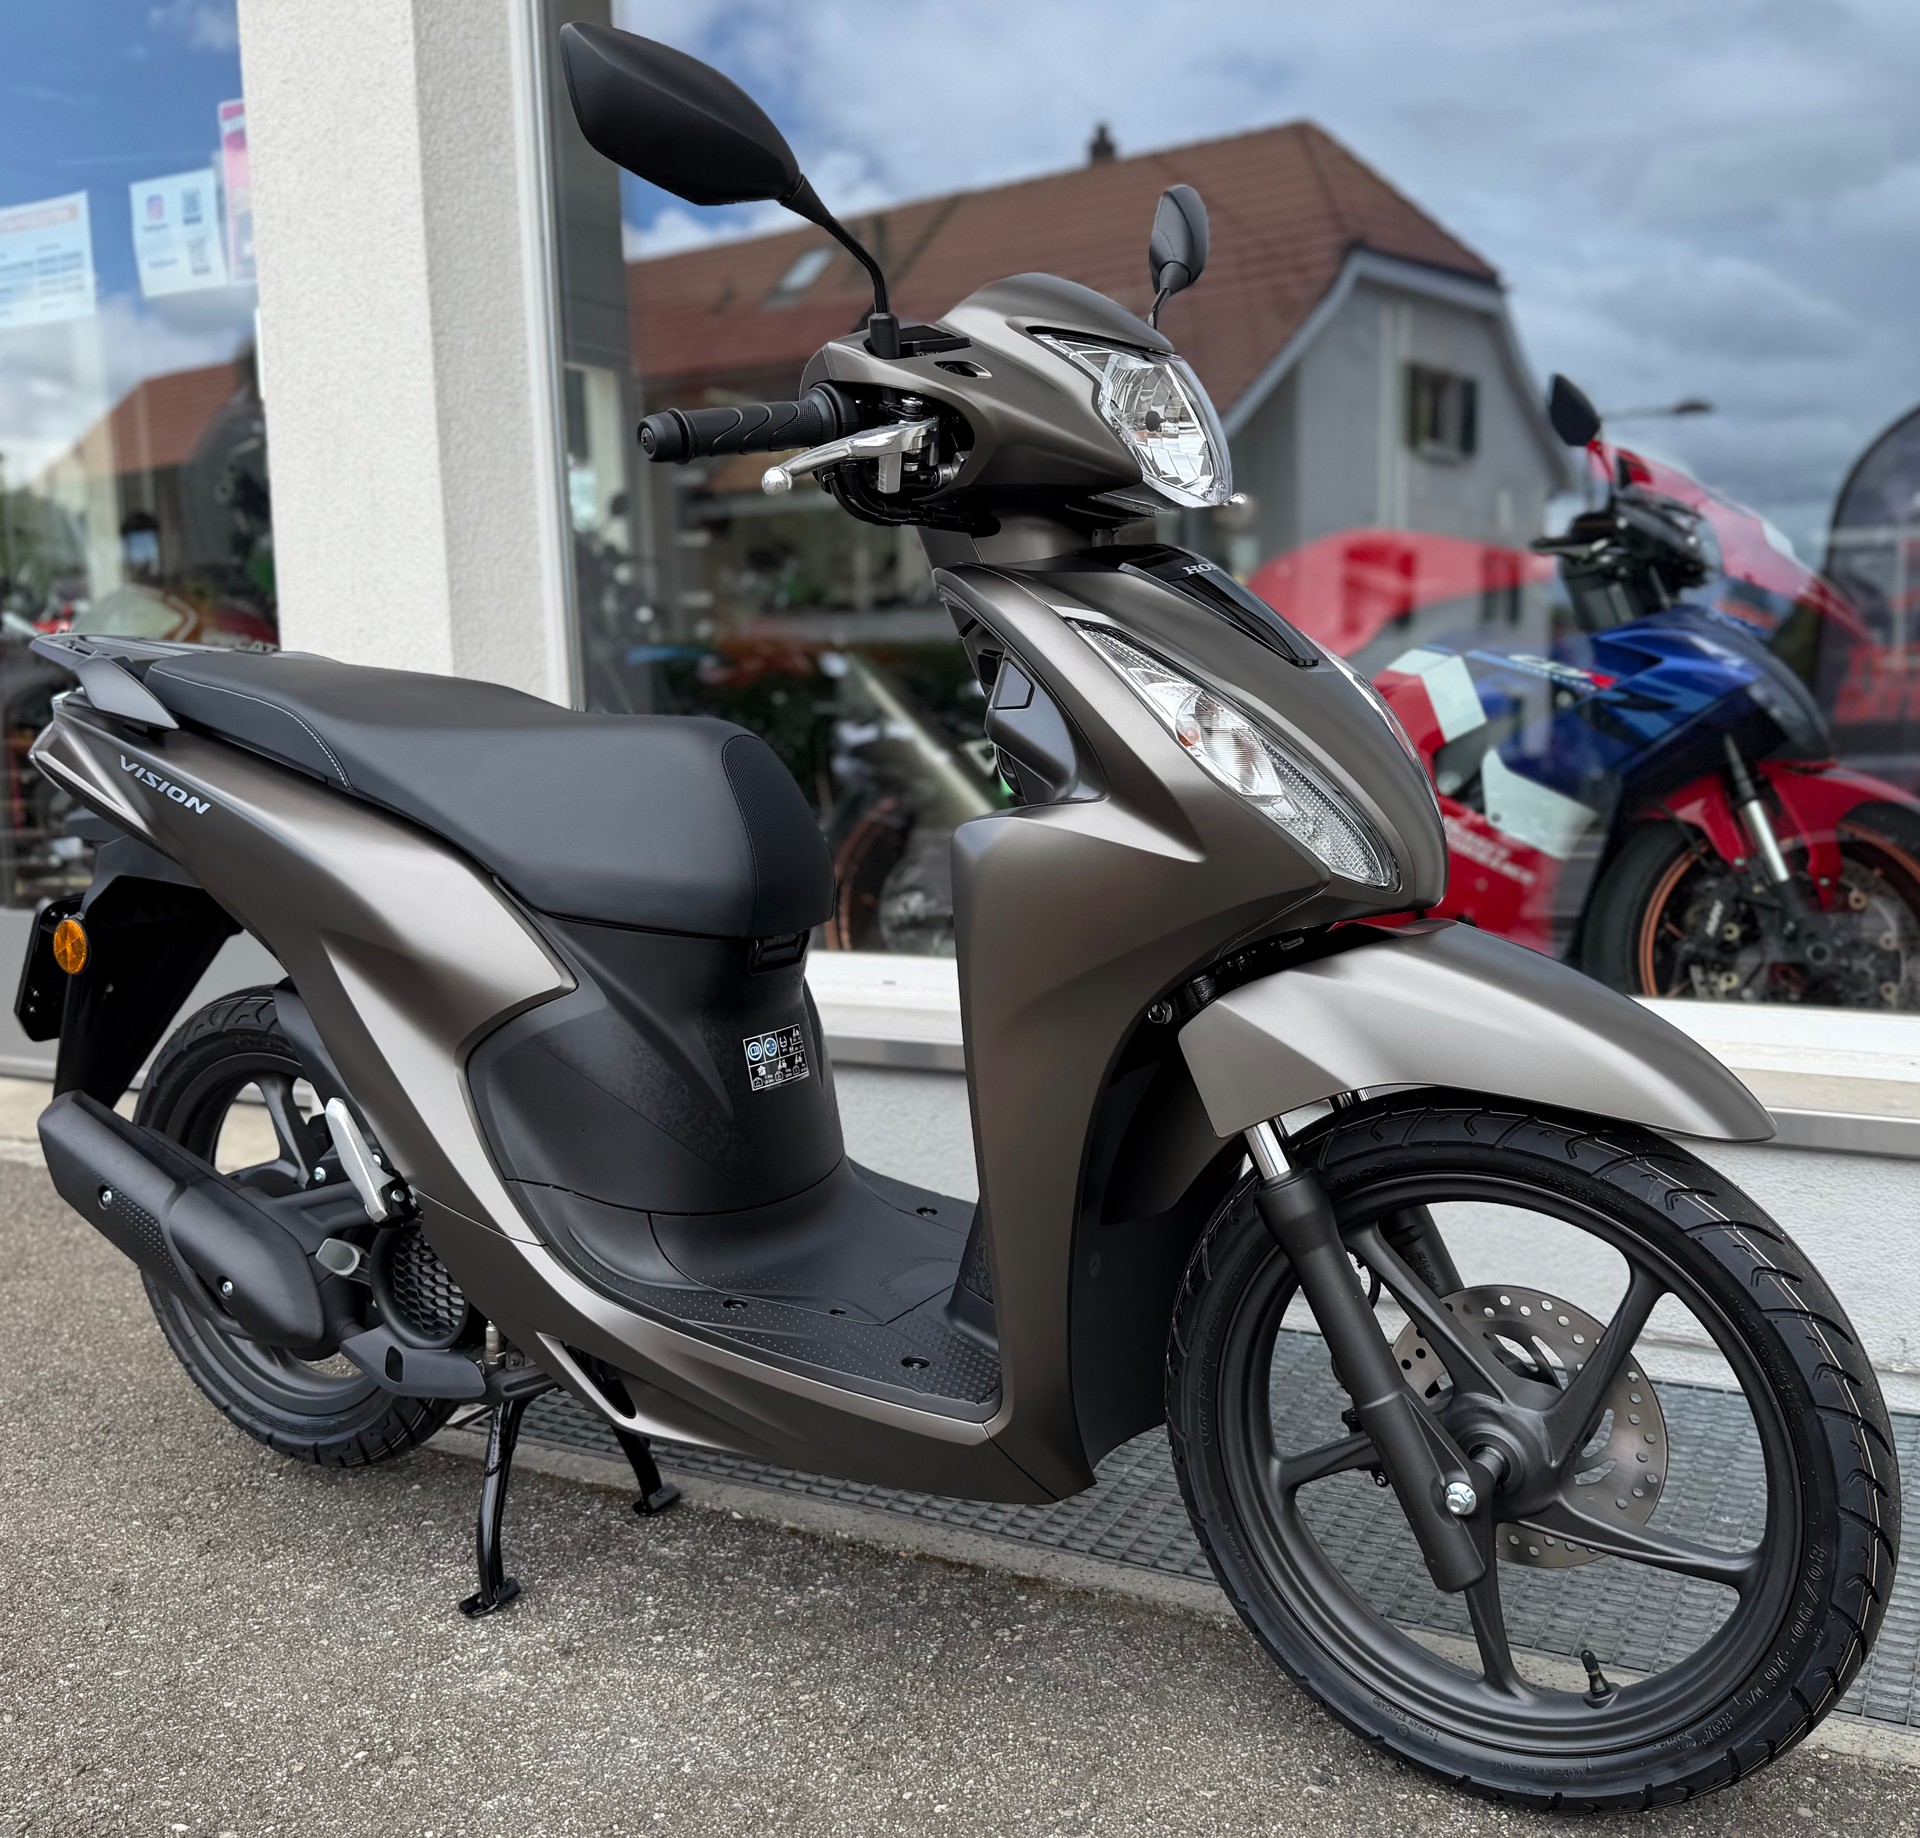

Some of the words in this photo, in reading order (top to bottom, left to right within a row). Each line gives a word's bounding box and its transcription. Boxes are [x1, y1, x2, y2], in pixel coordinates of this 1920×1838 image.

[120, 754, 211, 815] VISION
[1373, 1697, 1407, 1722] STANDARD
[1409, 1719, 1434, 1737] TAIWAN
